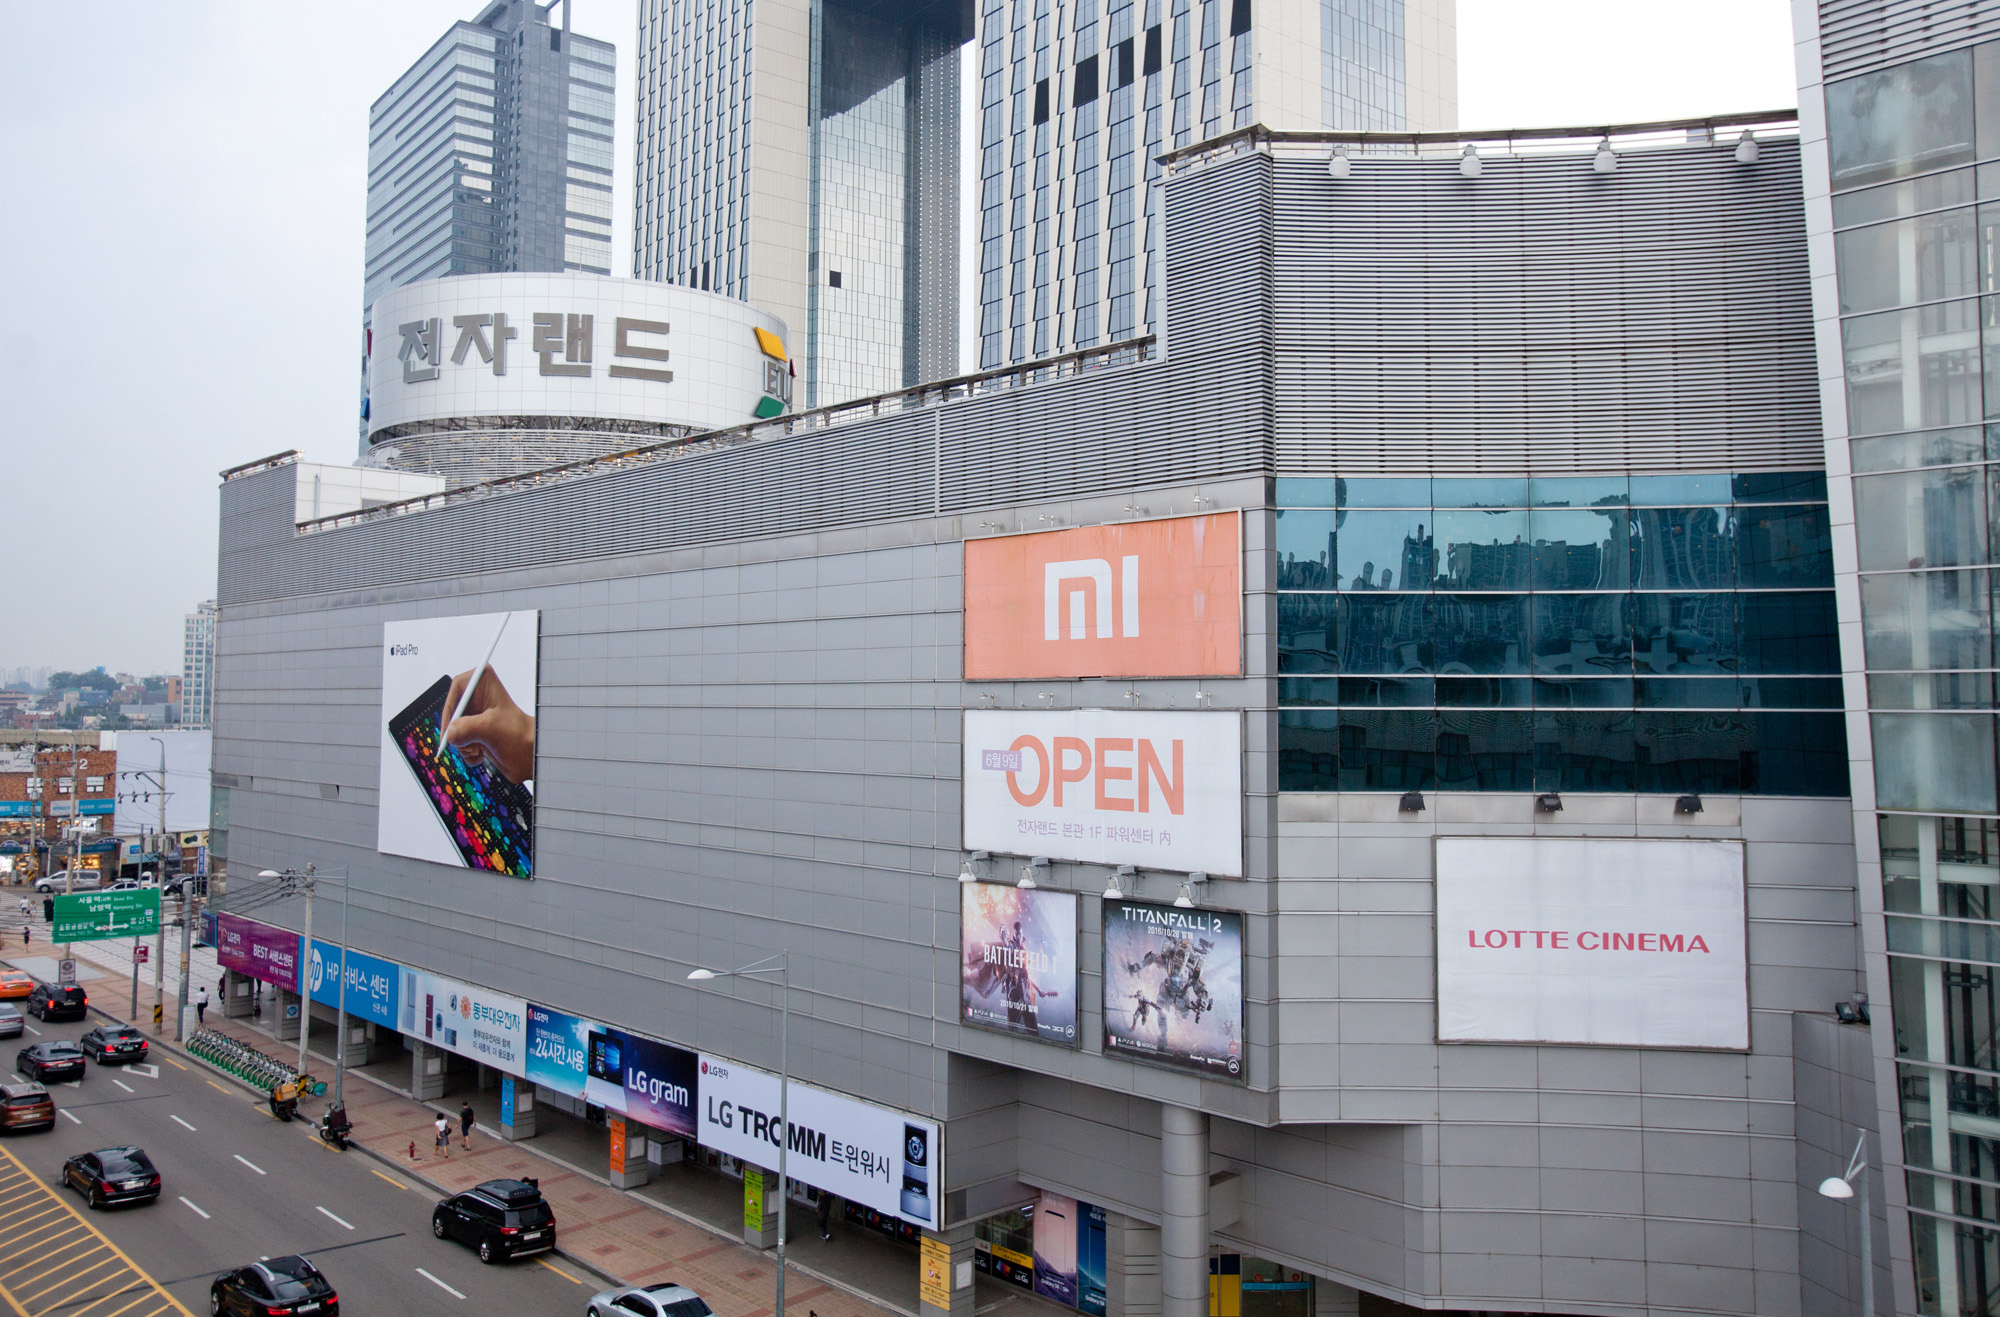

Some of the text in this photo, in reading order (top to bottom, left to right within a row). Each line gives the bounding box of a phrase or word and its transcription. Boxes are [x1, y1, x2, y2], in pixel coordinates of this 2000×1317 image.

[397, 312, 673, 384] 전자랜드
[396, 644, 418, 656] iPad Pro
[1005, 735, 1184, 816] OPEN
[1017, 818, 1059, 836] 전자랜드
[1062, 822, 1084, 839] 본관
[1089, 826, 1102, 839] 1F
[1106, 827, 1154, 846] 파워센터
[1122, 906, 1222, 933] TITANFALL 2
[1468, 929, 1711, 954] LOTTE CINEMA
[253, 944, 294, 968] BEST 서비스센터
[984, 944, 1049, 973] BATTLEFIELD
[326, 961, 339, 983] HP
[370, 974, 389, 1003] 센터
[473, 1002, 521, 1032] 동부대우전자
[534, 1011, 549, 1024] LG전자
[473, 1028, 511, 1049] 동부대우전자와 함께
[473, 1040, 478, 1050] 더
[492, 1047, 498, 1056] 더
[535, 1038, 566, 1067] 24시간
[566, 1048, 585, 1073] 사용
[709, 1064, 729, 1079] LG전자
[628, 1067, 689, 1108] LG gram
[708, 1096, 891, 1184] LG TROMM 트윈워시
